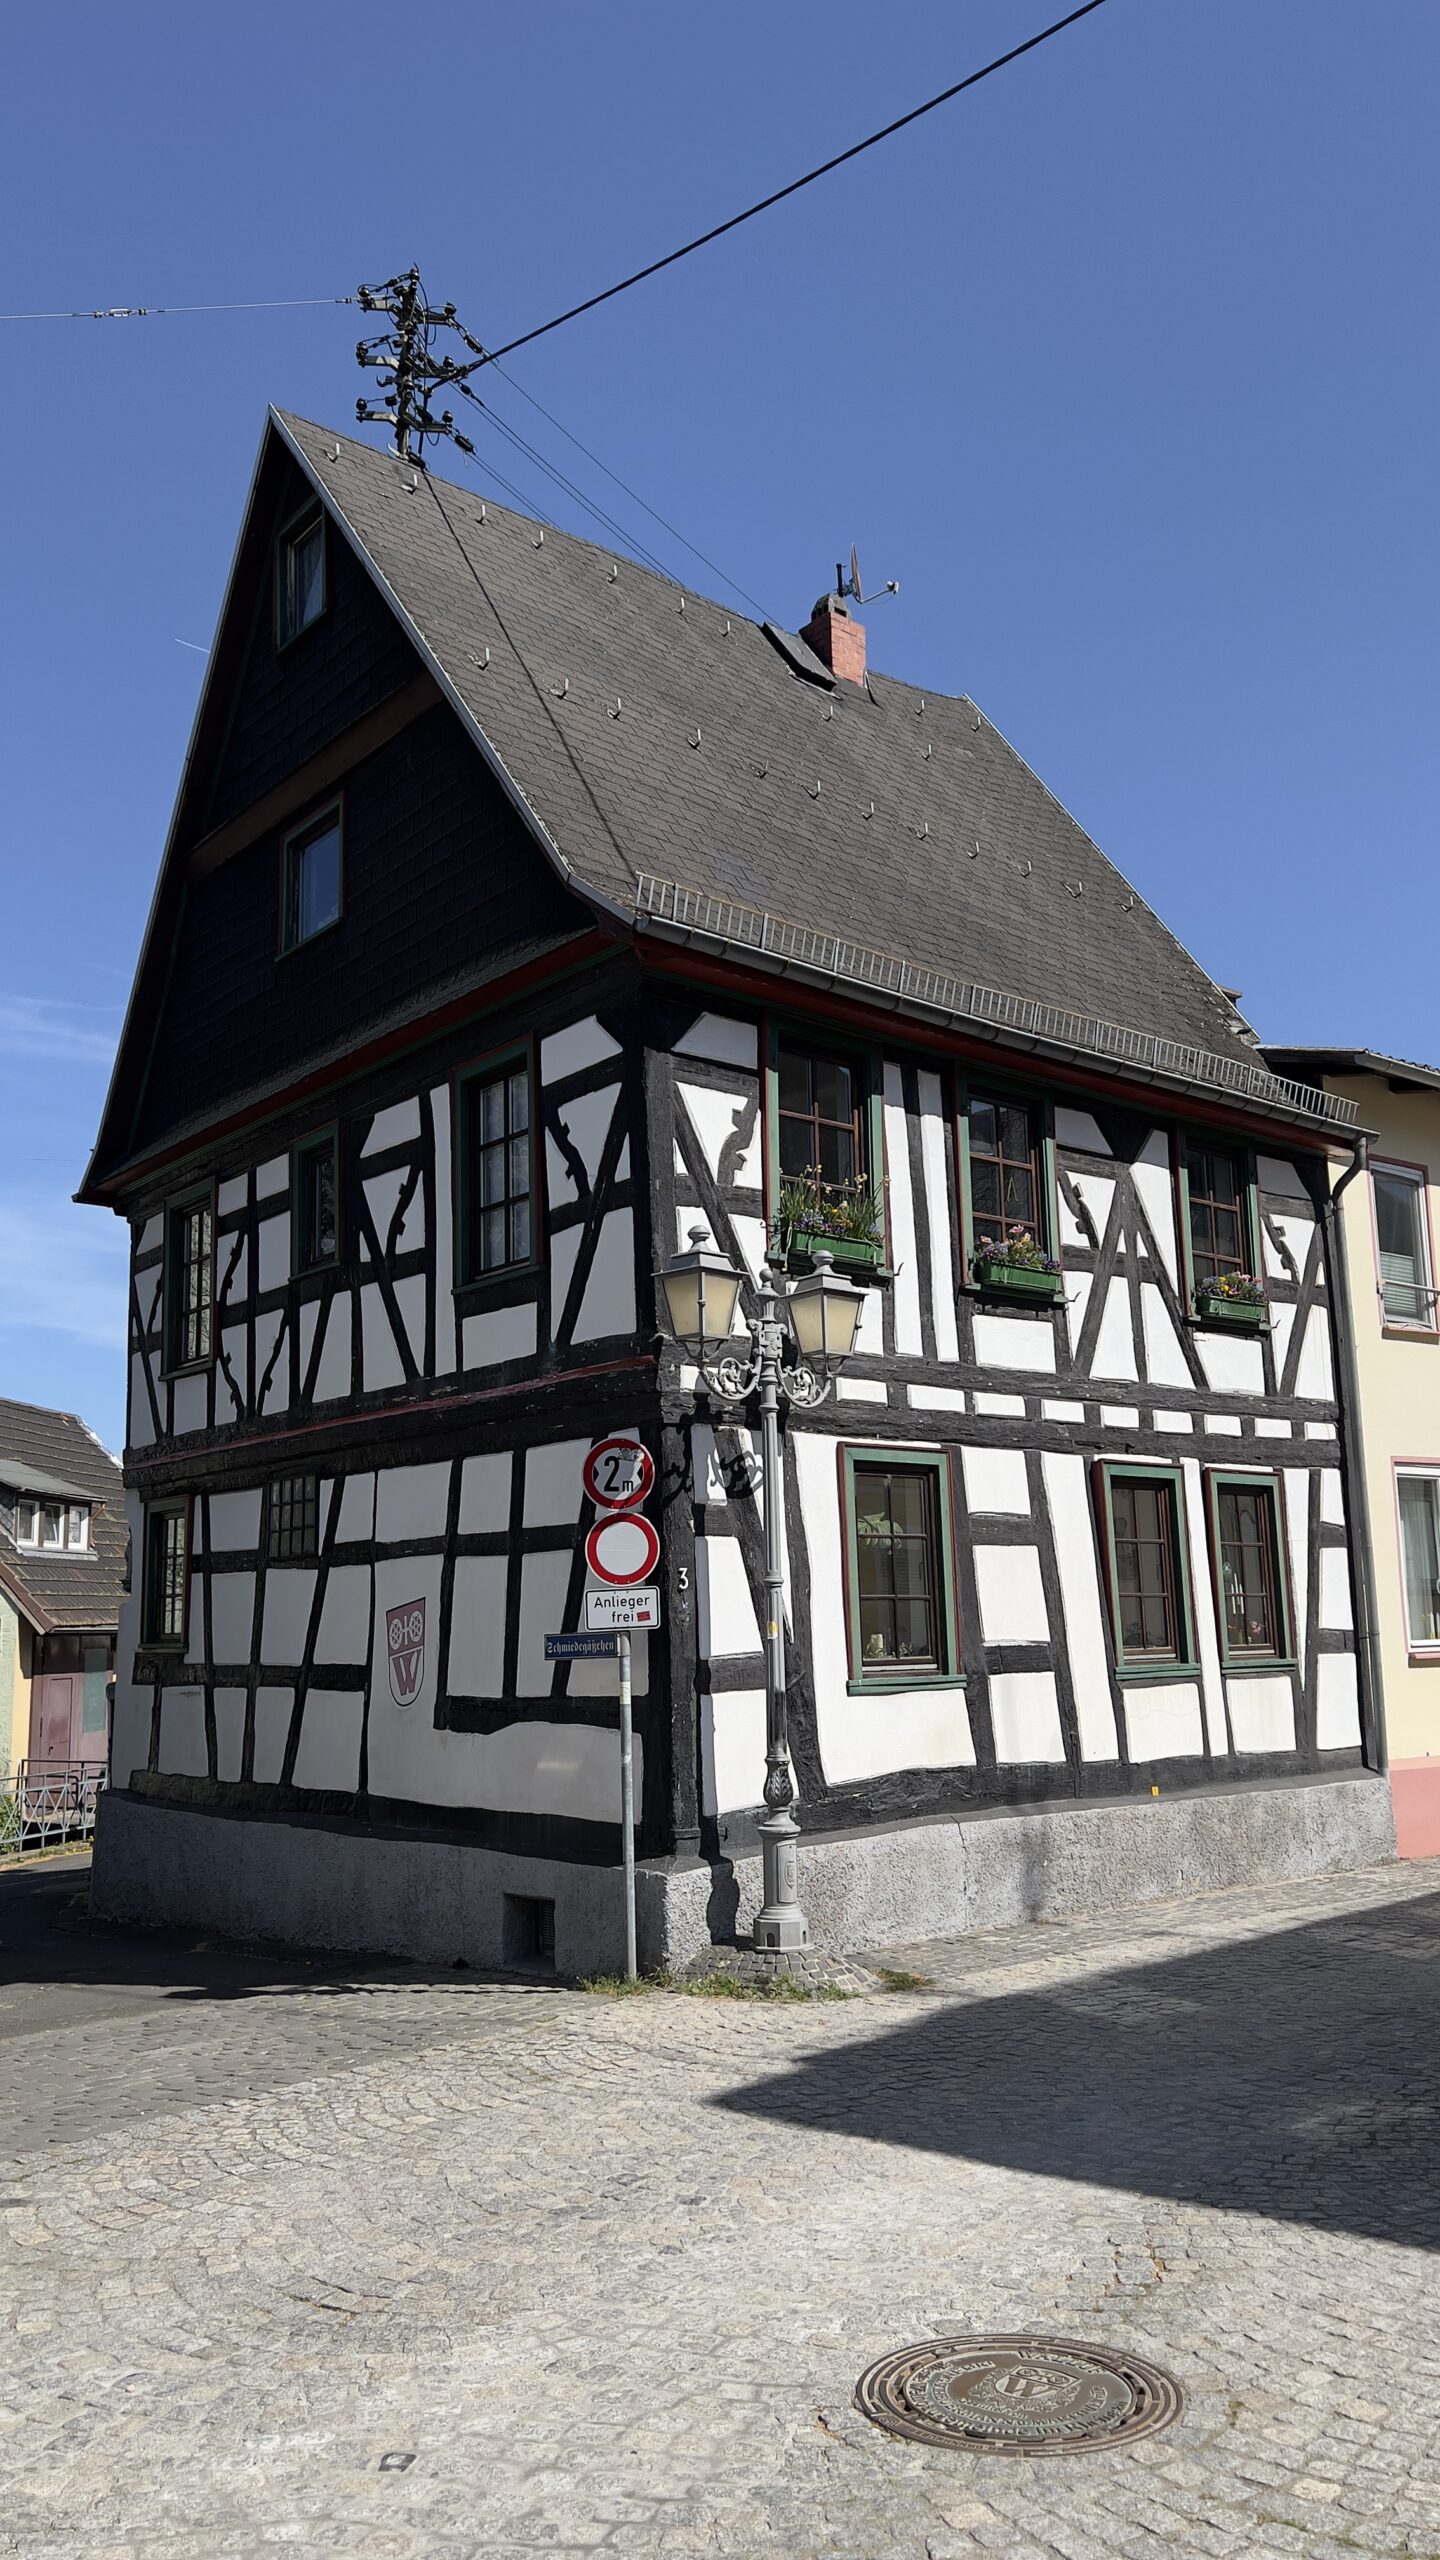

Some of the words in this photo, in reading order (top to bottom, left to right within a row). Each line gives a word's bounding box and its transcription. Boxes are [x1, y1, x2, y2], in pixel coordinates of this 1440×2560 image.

[603, 1456, 620, 1492] 2
[622, 1481, 634, 1492] m
[677, 1567, 689, 1590] 3
[594, 1596, 650, 1610] Anlieger
[612, 1610, 634, 1623] frei
[391, 1648, 422, 1697] W
[1018, 2350, 1107, 2375] WALLUF
